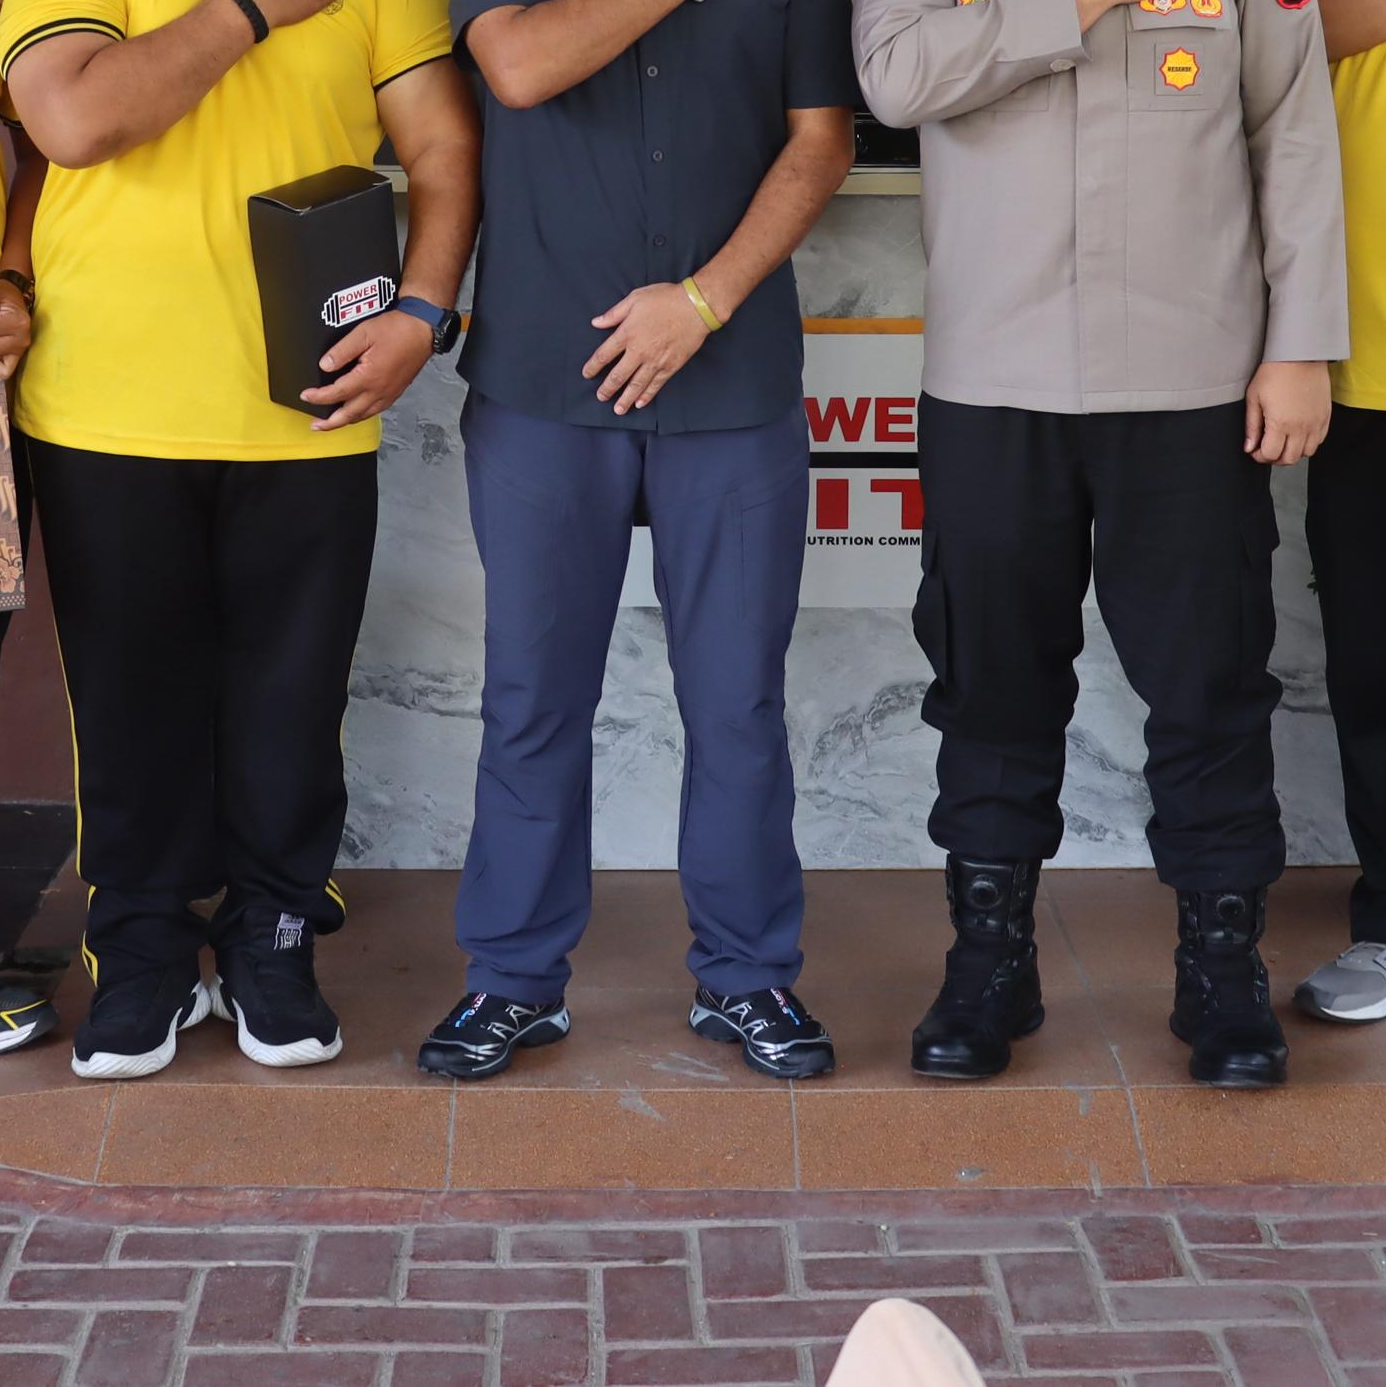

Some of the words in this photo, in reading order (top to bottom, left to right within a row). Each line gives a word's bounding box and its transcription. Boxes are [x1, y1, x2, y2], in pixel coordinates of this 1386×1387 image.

[339, 284, 378, 305] POWER
[340, 298, 379, 320] FIT
[806, 535, 874, 546] UTRITION
